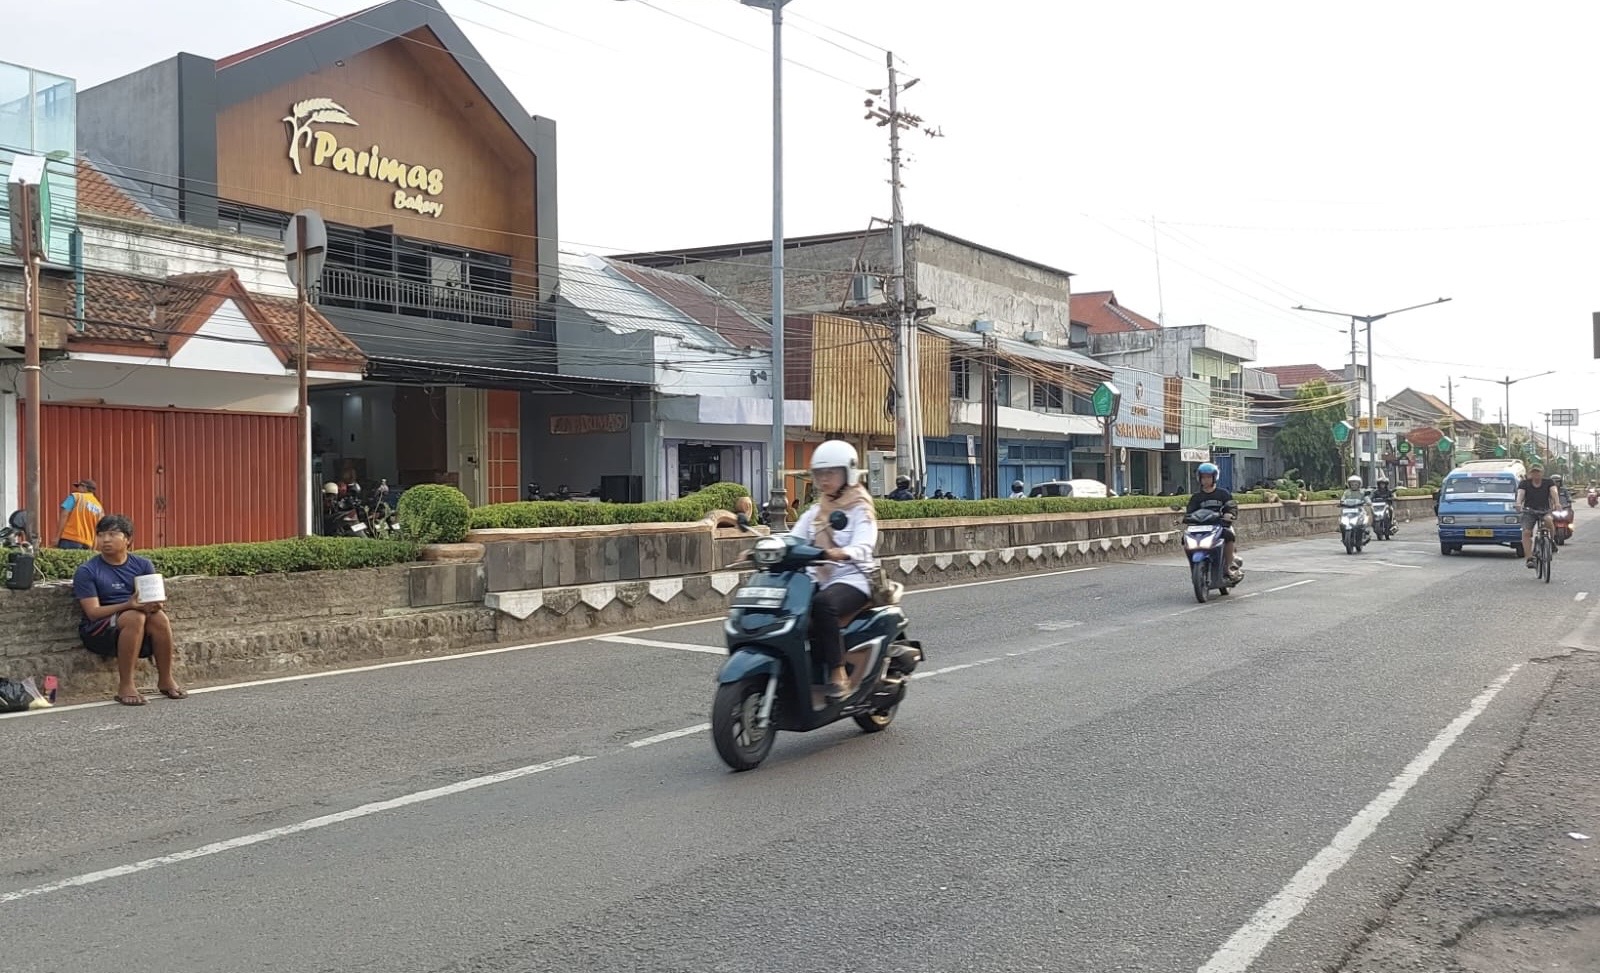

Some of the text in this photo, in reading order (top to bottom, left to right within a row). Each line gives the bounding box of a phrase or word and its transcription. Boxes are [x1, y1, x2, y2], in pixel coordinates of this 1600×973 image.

[313, 130, 444, 195] Parimas
[393, 189, 443, 218] Bakery
[1115, 422, 1134, 438] SARI
